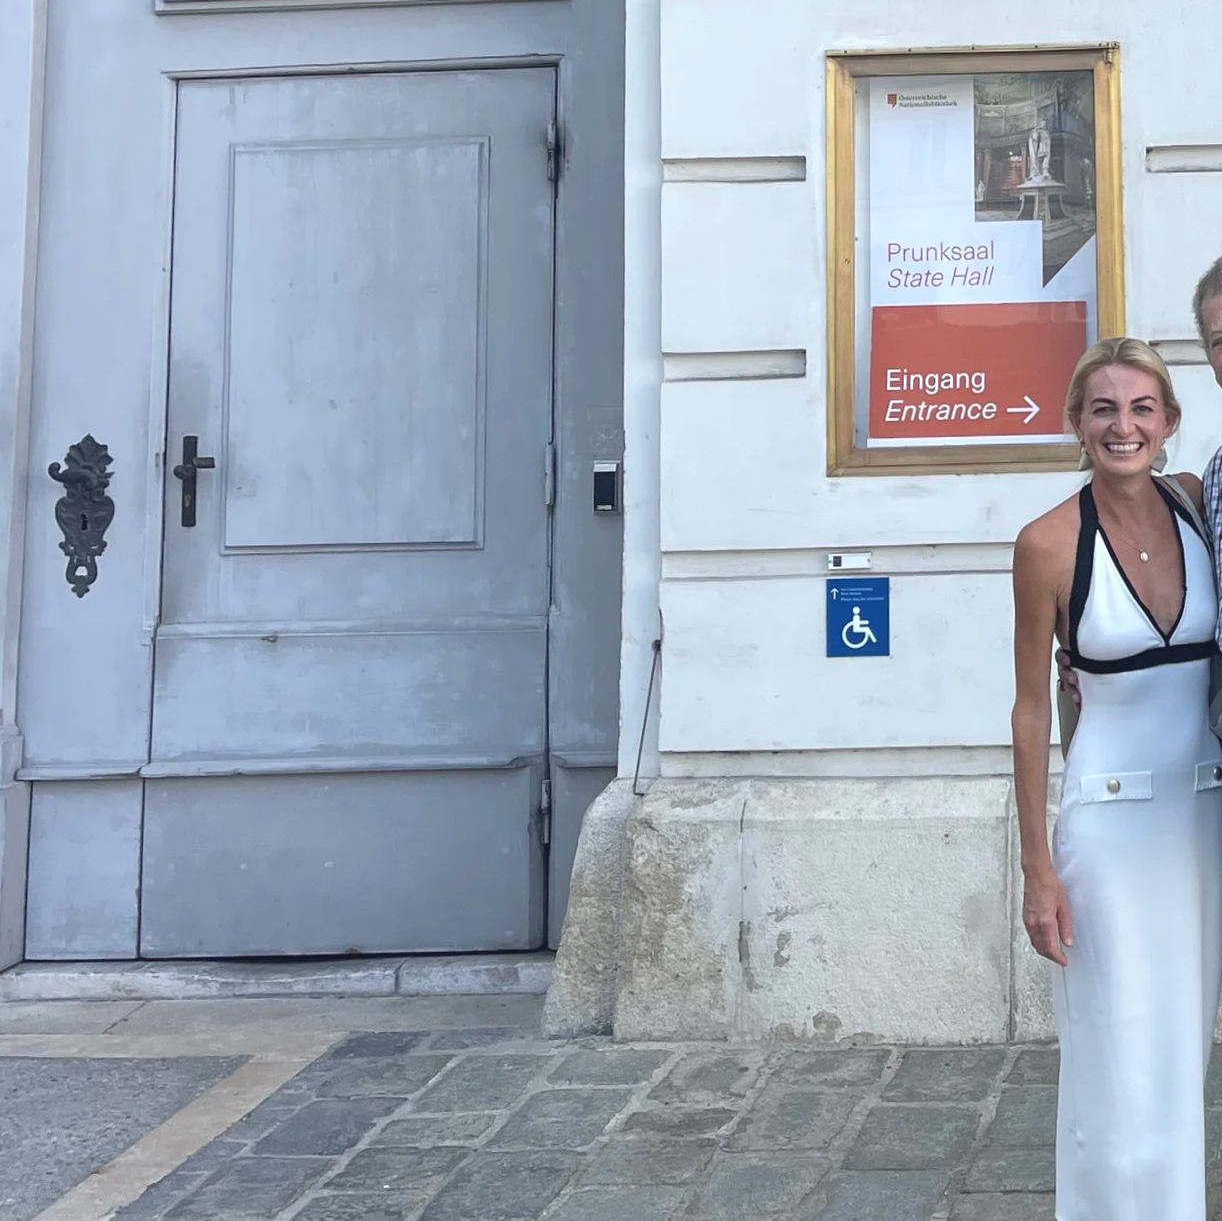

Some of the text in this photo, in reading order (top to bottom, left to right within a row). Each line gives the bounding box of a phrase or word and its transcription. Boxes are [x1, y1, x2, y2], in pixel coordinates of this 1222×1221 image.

[887, 240, 995, 262] Prunksaal
[887, 265, 995, 289] State Hall
[886, 369, 986, 395] Eingang
[884, 399, 997, 422] Entrance
